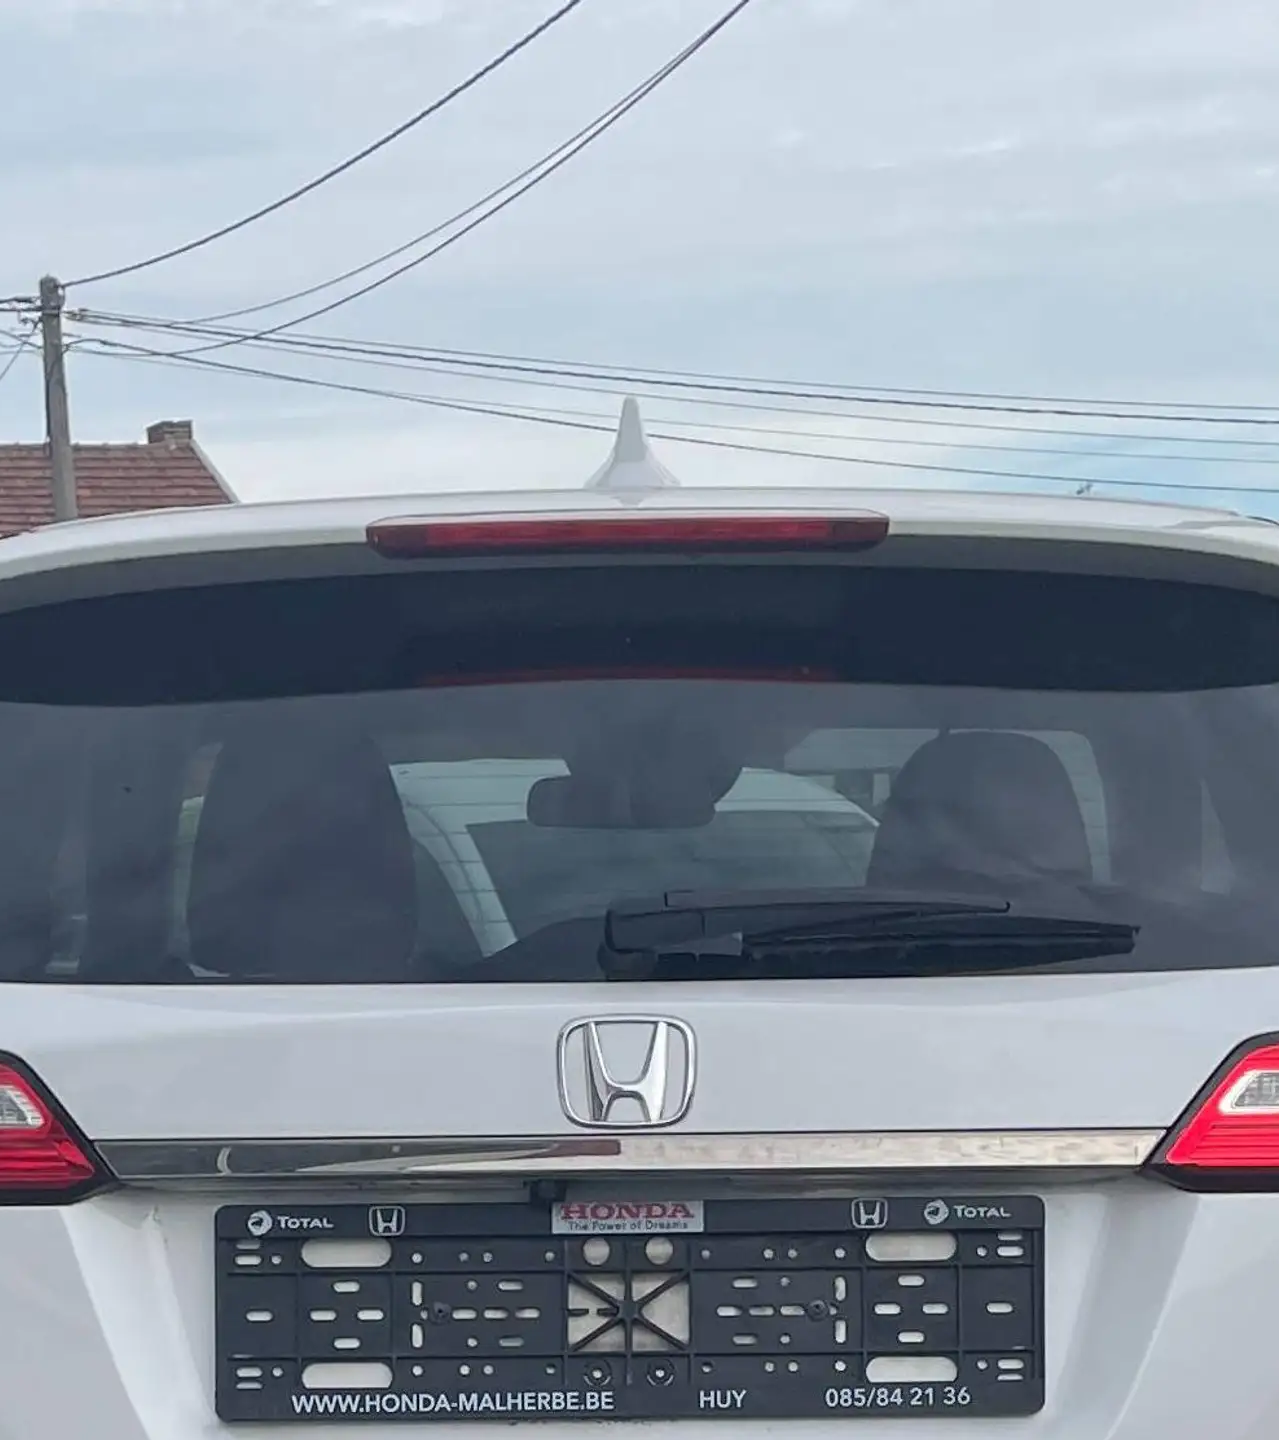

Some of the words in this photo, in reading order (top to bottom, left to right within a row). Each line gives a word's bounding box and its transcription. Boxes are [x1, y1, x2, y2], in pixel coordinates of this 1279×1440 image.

[561, 1203, 695, 1221] HONDA
[569, 1220, 588, 1231] The
[593, 1219, 627, 1231] Power
[630, 1218, 642, 1230] of
[646, 1218, 689, 1230] Dreams
[292, 1391, 615, 1414] WWW.HONDA-MALHERBE.BE
[699, 1389, 747, 1409] HUY
[825, 1387, 903, 1408] 085/84
[909, 1387, 934, 1406] 21
[943, 1386, 971, 1406] 36
